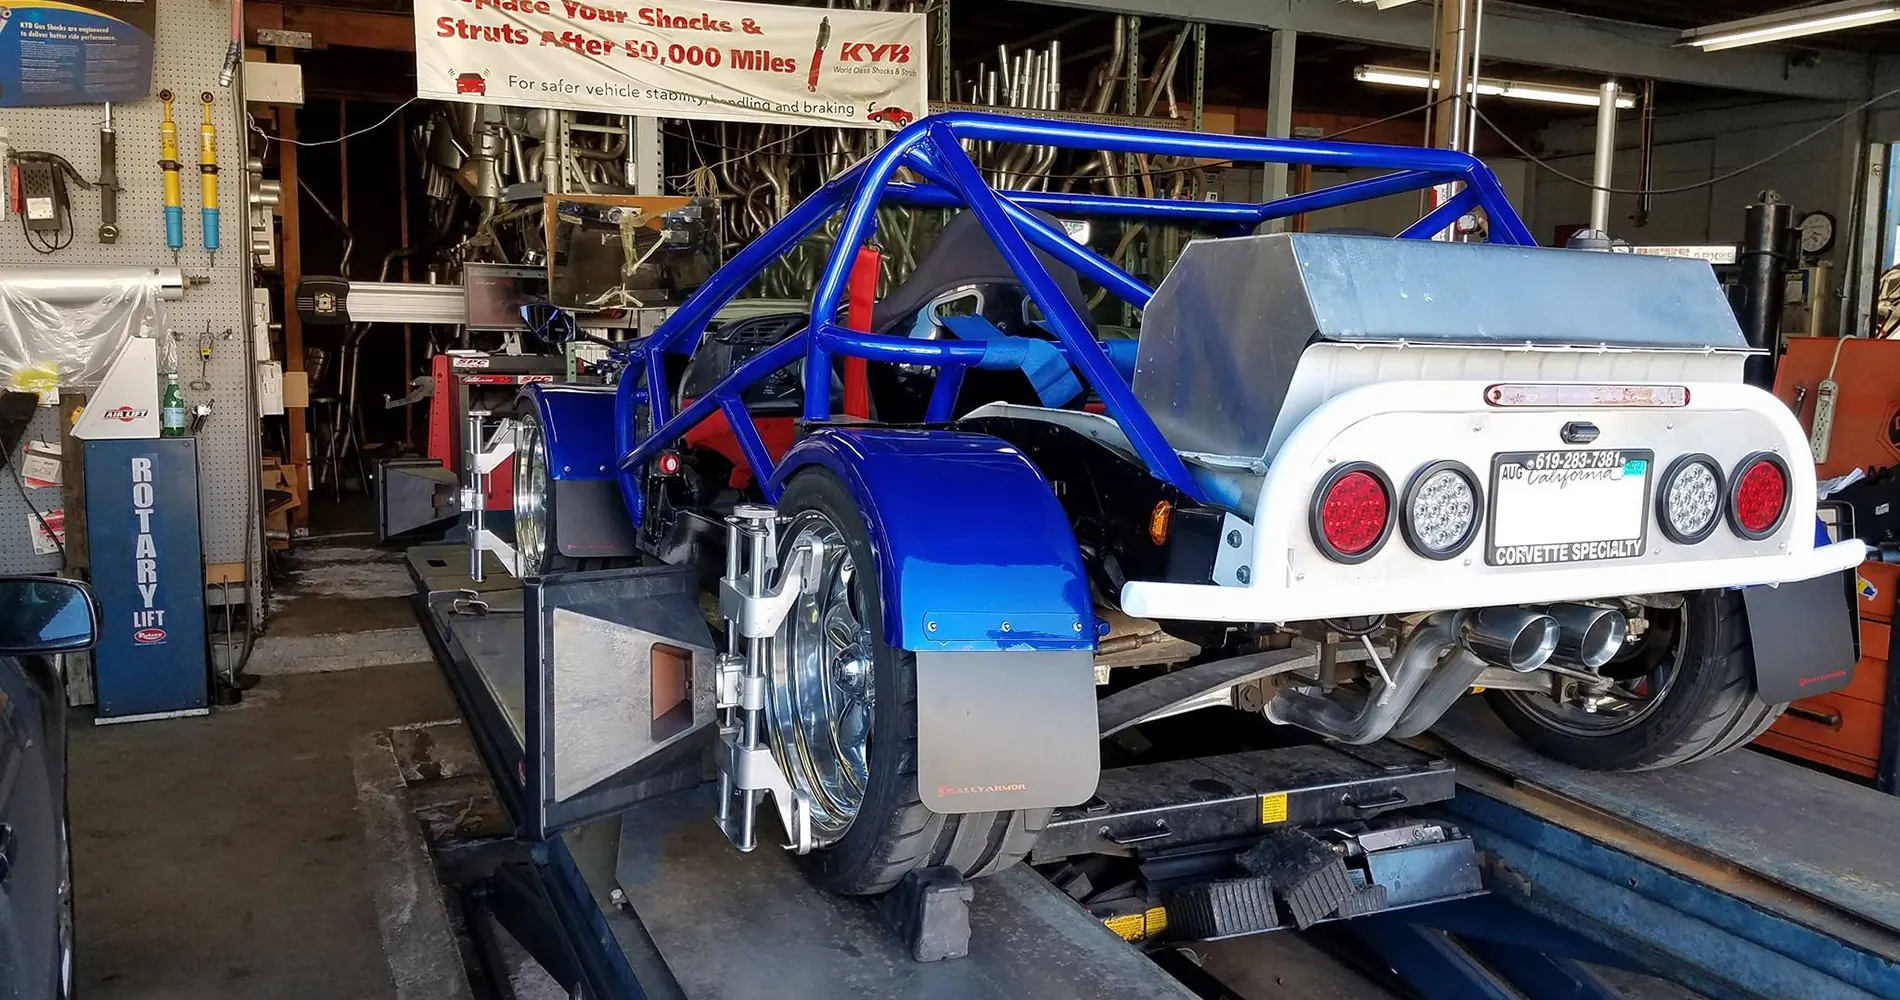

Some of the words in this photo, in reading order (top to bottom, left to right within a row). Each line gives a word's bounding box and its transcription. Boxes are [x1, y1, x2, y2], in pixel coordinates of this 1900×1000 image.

[20, 21, 33, 29] KYB
[46, 24, 66, 32] Shocks
[78, 26, 109, 34] engineered
[561, 0, 628, 24] Your
[638, 8, 734, 33] Shocks
[741, 17, 765, 36] &
[437, 16, 529, 45] Struts
[539, 31, 616, 57] After
[625, 40, 722, 68] 50,000
[731, 48, 797, 74] Miles
[840, 42, 910, 63] KYB
[833, 66, 852, 75] World
[853, 66, 871, 75] Class
[872, 66, 894, 75] Shocks
[894, 68, 900, 76] &
[901, 68, 917, 78] Struts
[508, 75, 535, 90] For
[541, 78, 581, 95] safer
[586, 82, 641, 99] vehicle
[775, 101, 799, 113] and
[804, 103, 855, 117] braking
[1535, 451, 1621, 470] 619-283-7381
[1502, 465, 1523, 480] AUG
[1527, 467, 1622, 490] California
[131, 457, 158, 608] ROTARY
[1496, 545, 1569, 566] CORVETTE
[1571, 539, 1642, 562] SPECIALTY
[133, 610, 165, 628] LIFT
